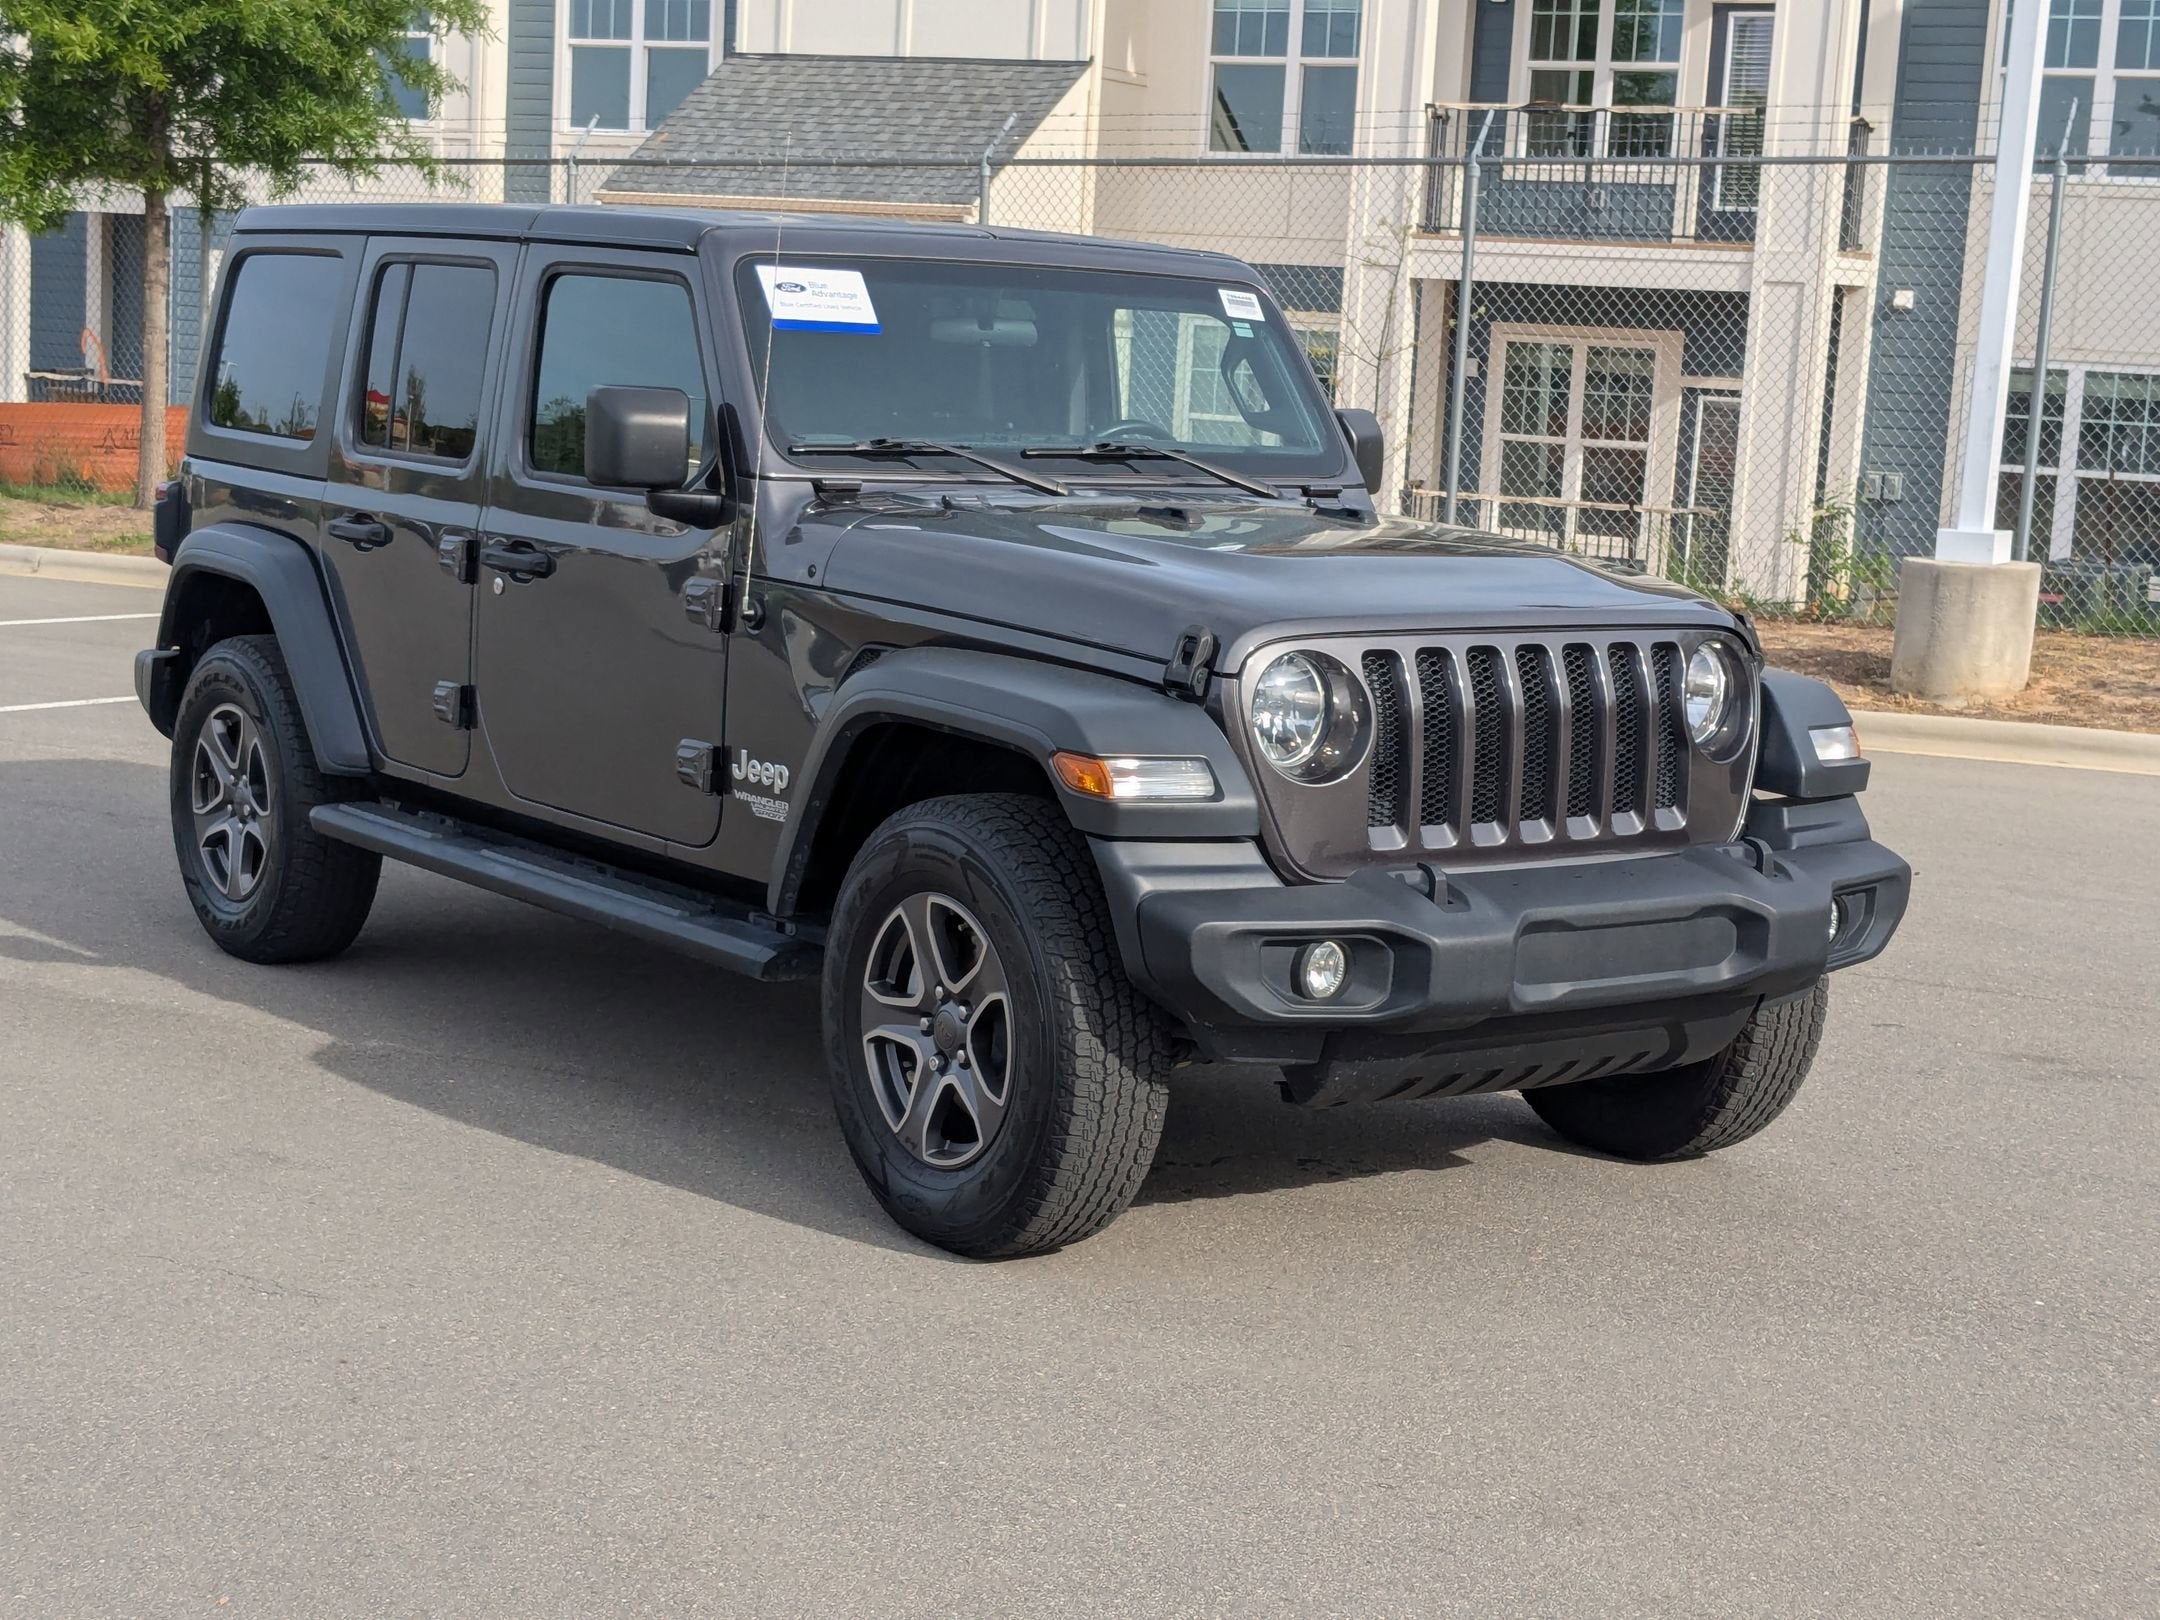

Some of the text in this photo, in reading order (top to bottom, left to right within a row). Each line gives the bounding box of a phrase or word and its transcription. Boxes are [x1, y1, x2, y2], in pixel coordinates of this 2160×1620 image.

[811, 290, 858, 300] Advantage
[732, 749, 789, 794] Jeep
[733, 788, 789, 811] WRANGLER
